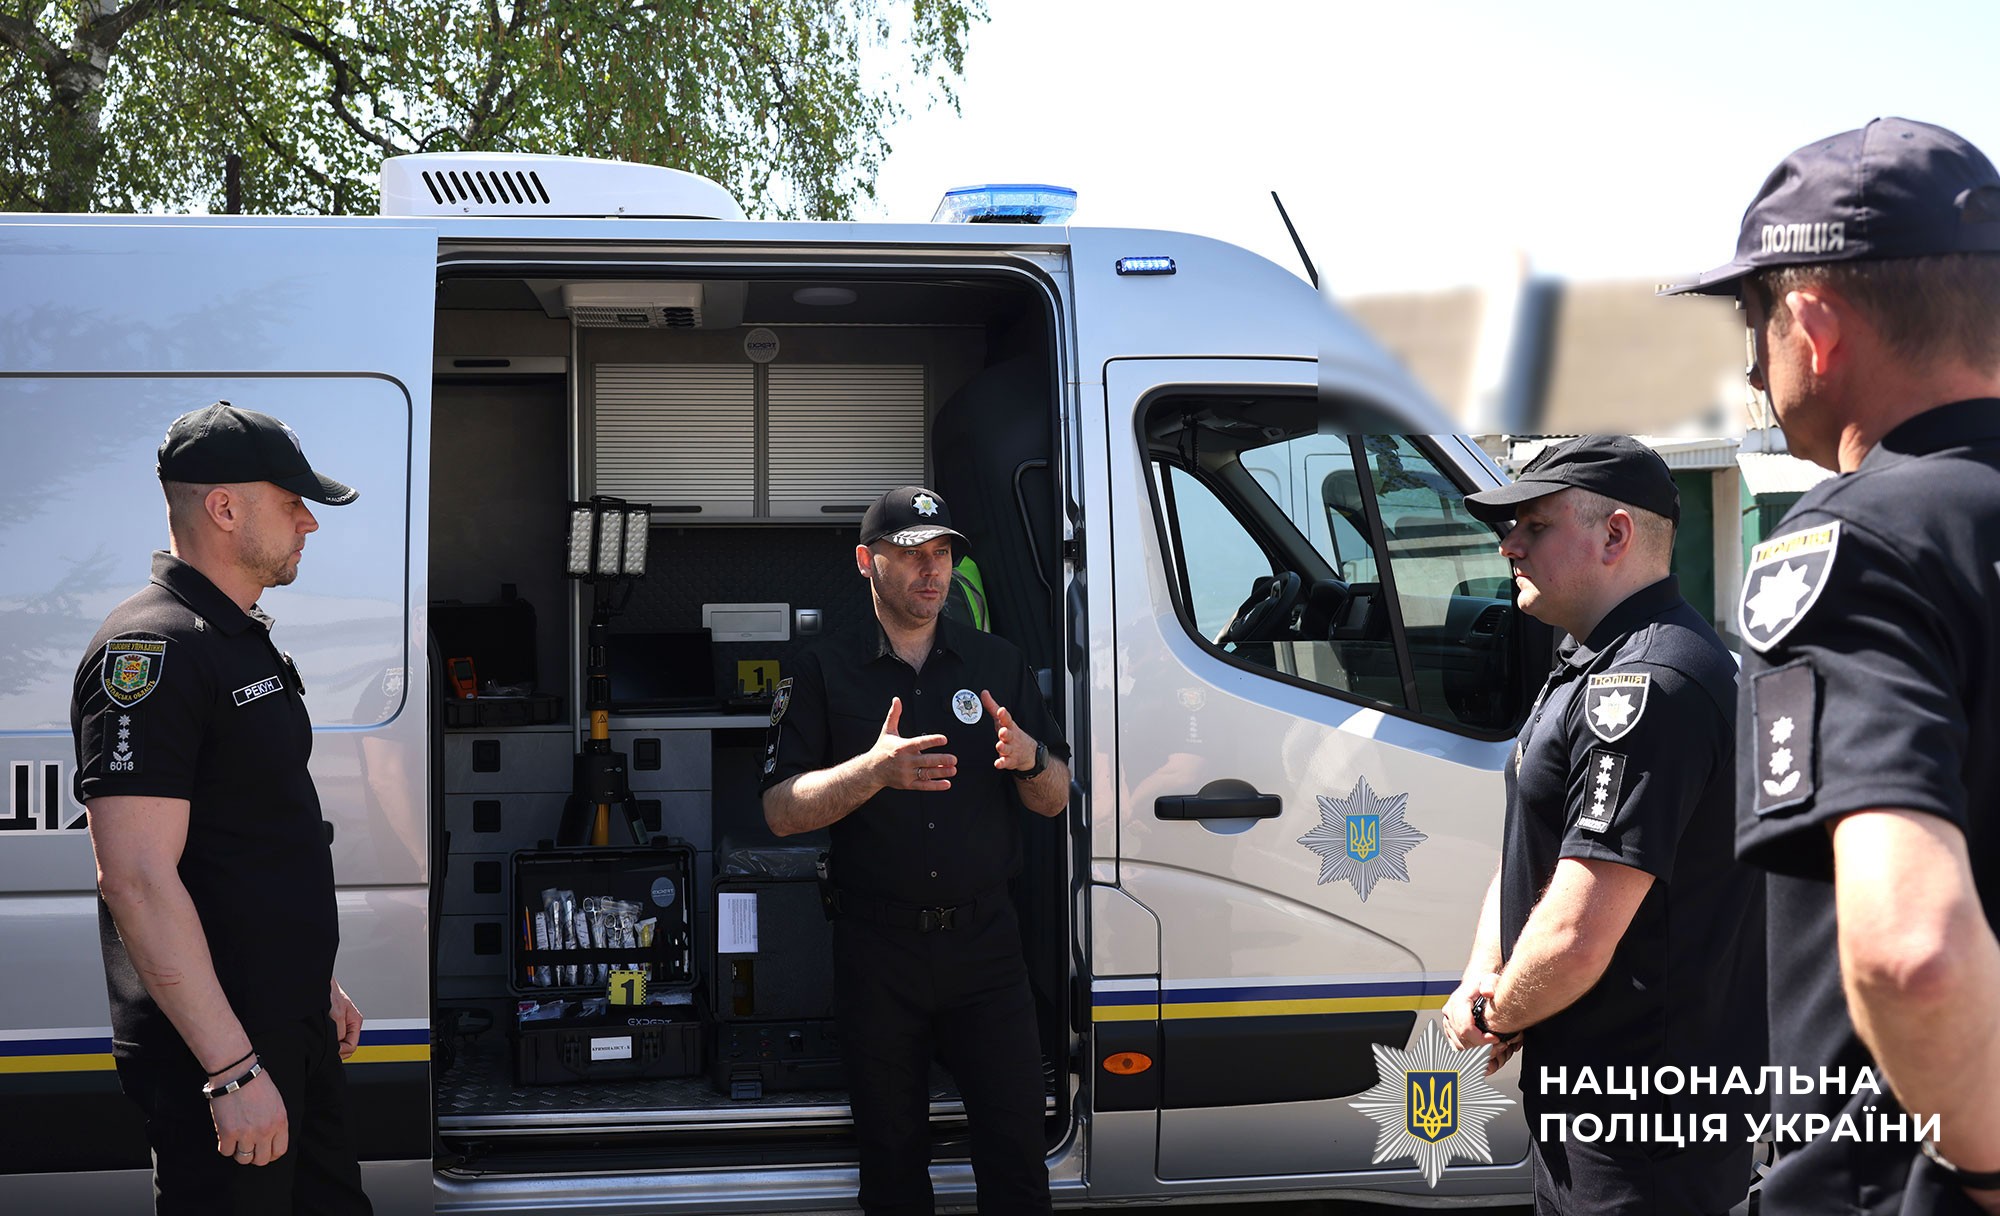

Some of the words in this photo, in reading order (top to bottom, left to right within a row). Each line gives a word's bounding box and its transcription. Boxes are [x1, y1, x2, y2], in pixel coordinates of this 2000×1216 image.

[1761, 222, 1845, 254] ПОЛІЦІЯ
[753, 667, 764, 686] 1
[1594, 674, 1643, 685] ПОЛІЦІЯ
[244, 680, 275, 699] РЕКУН
[109, 761, 134, 771] 6018
[620, 979, 635, 1005] 1
